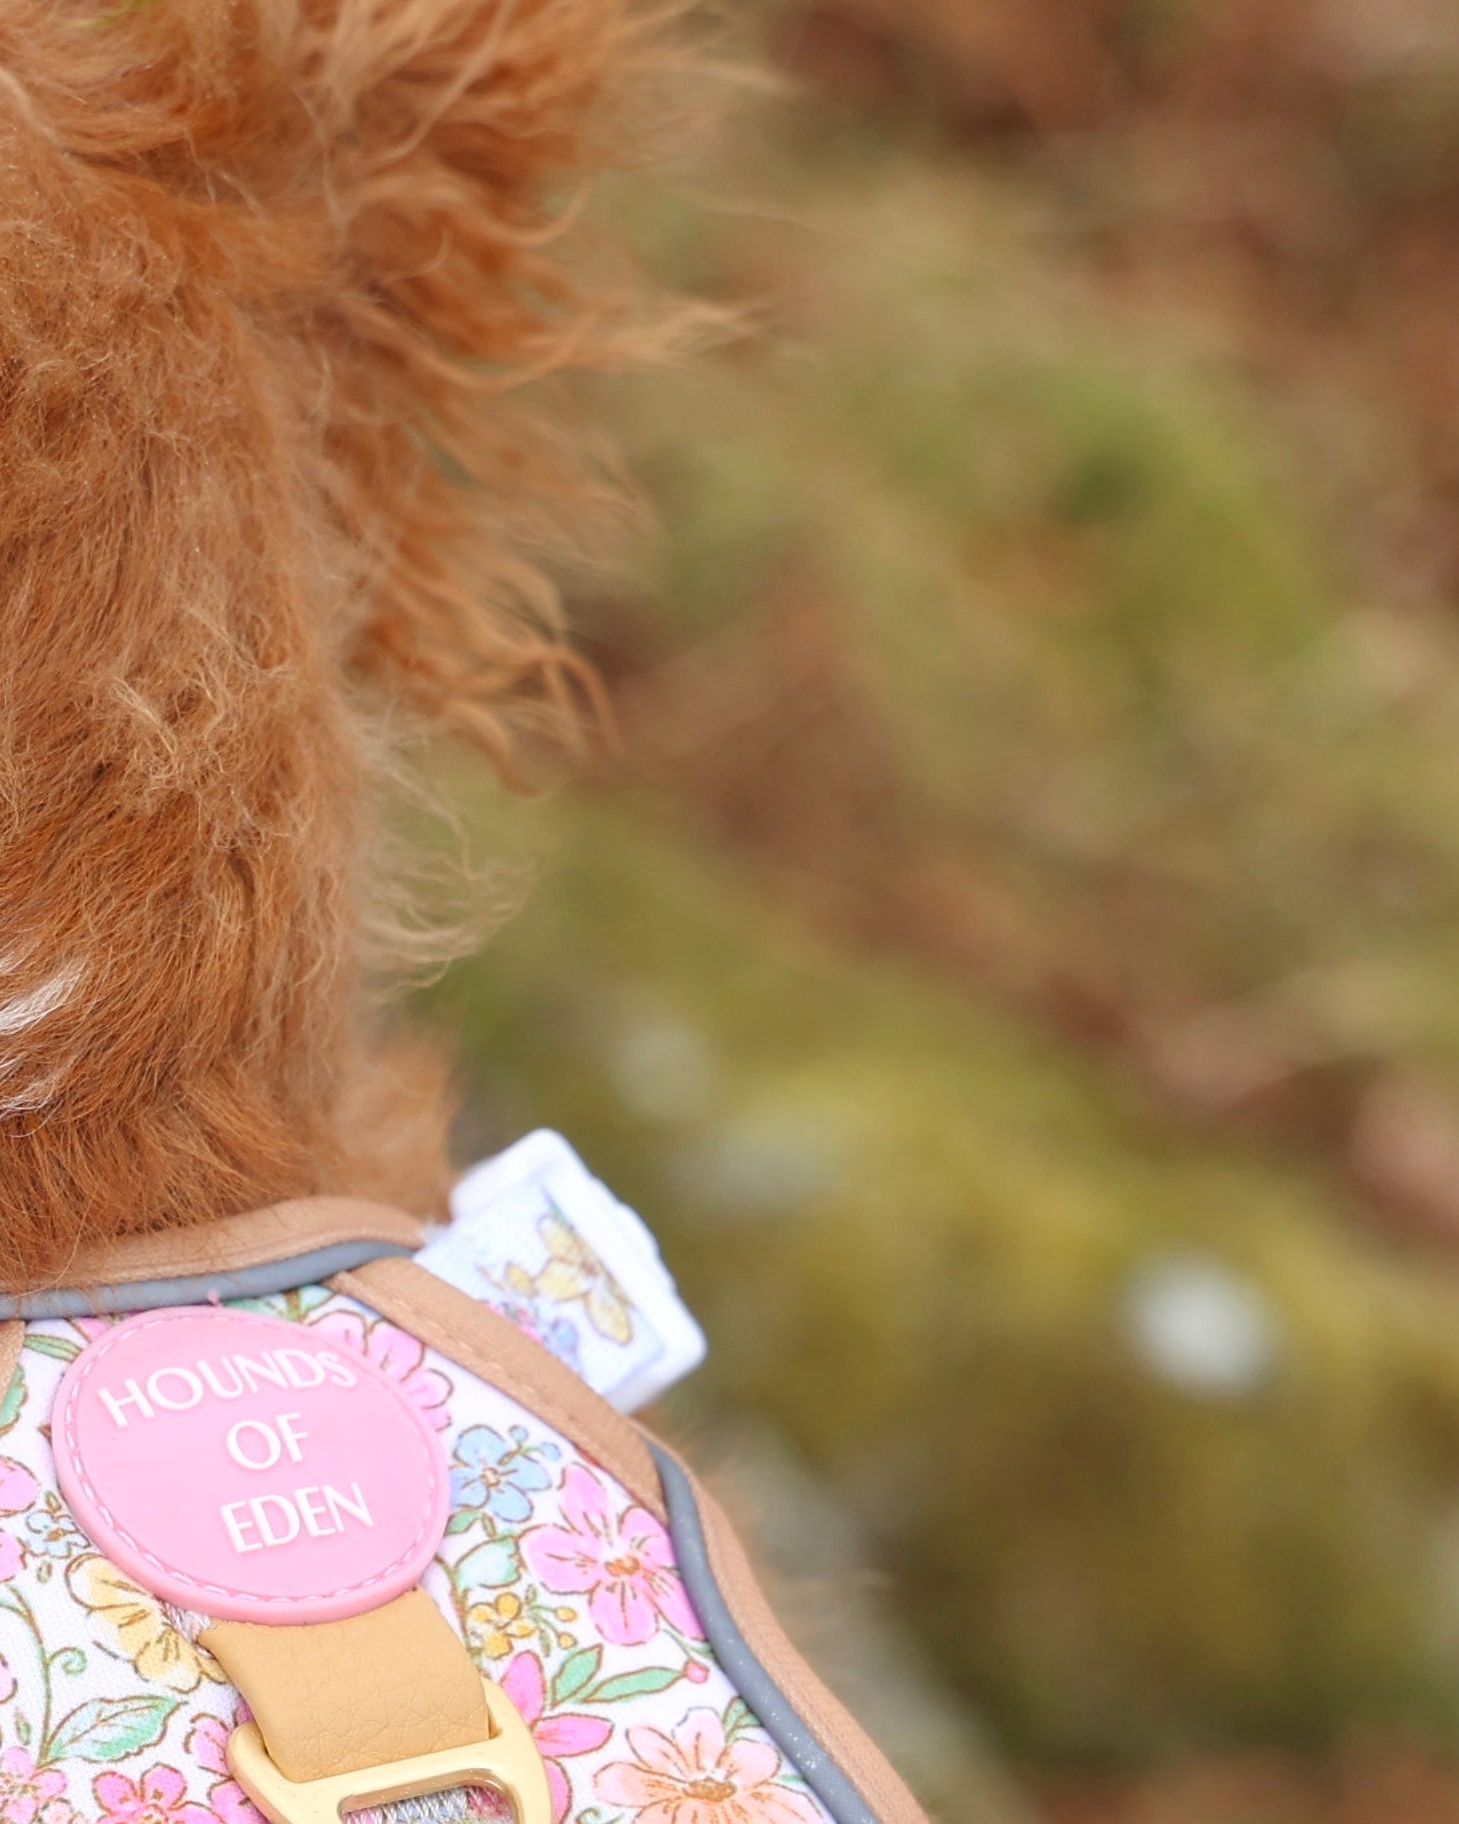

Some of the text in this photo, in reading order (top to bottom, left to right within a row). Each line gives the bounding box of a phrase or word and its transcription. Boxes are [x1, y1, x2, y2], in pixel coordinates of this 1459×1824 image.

[98, 1349, 356, 1427] HOUNDS
[225, 1412, 308, 1470] OF
[220, 1482, 374, 1553] EDEN
